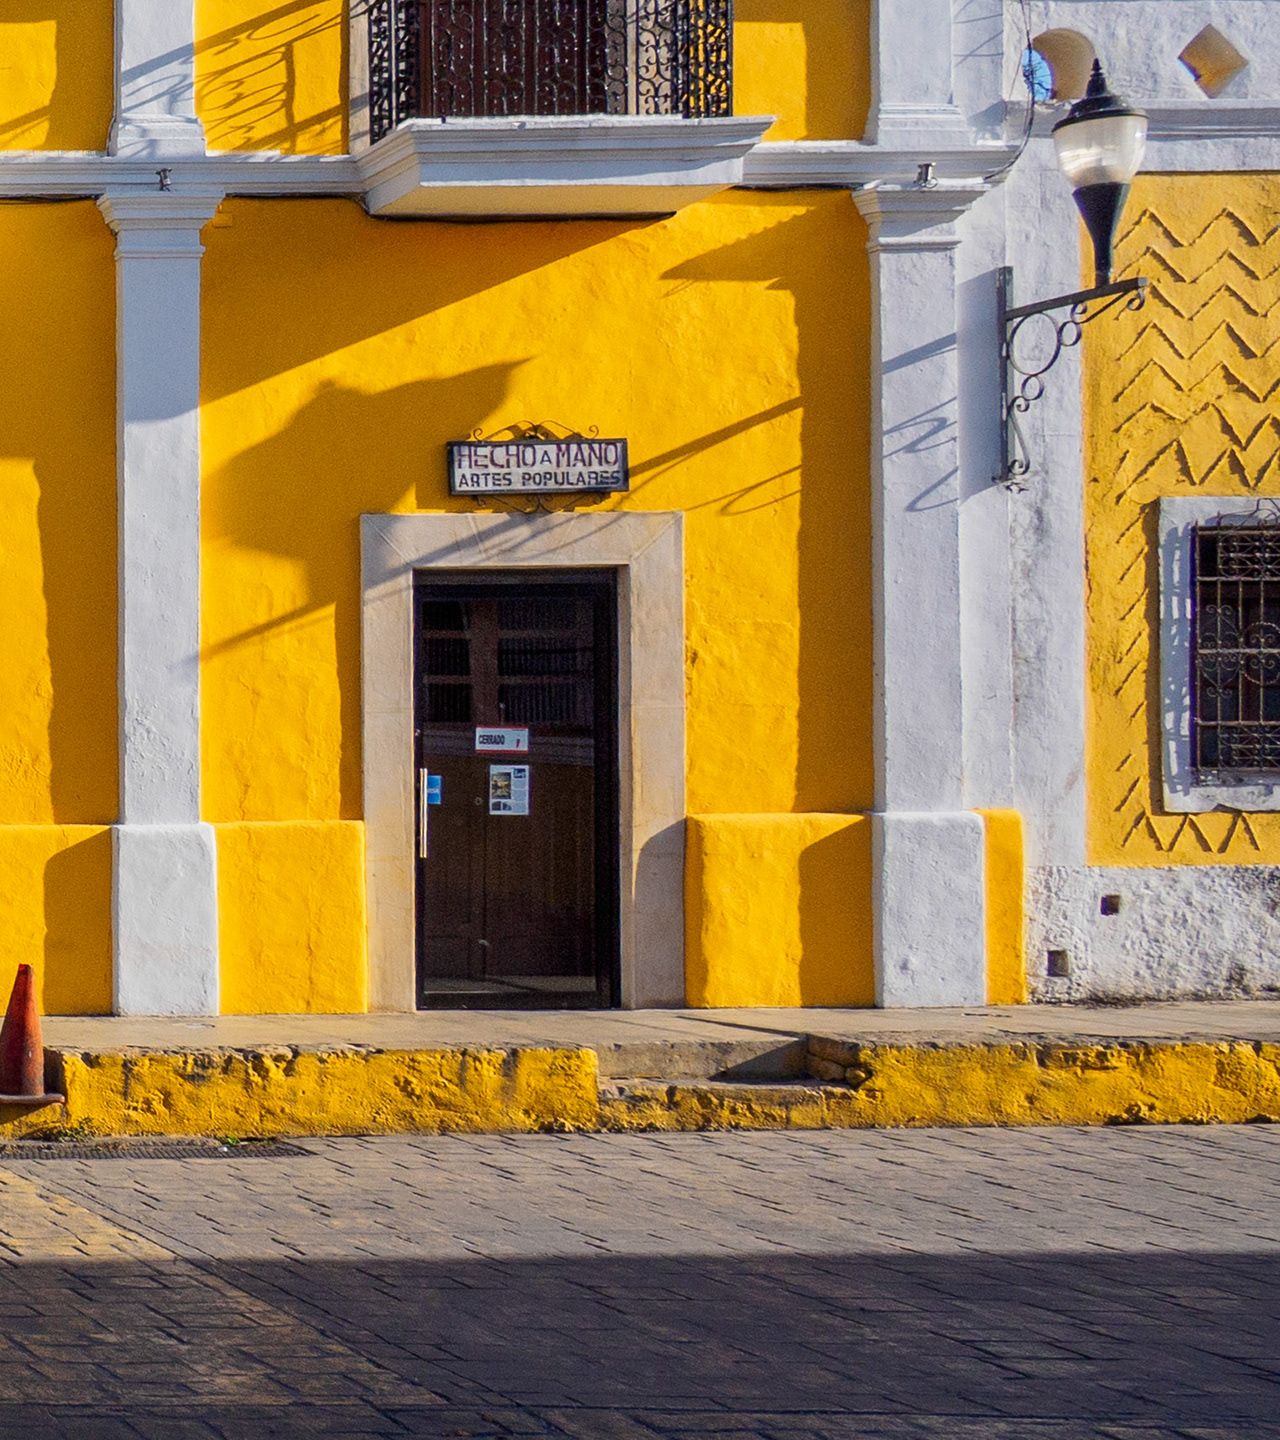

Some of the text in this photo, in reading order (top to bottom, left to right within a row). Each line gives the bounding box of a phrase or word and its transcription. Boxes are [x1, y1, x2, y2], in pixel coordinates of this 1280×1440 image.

[457, 443, 619, 469] HECHO A MANO
[458, 470, 622, 488] ARTES POPULARES
[479, 735, 505, 745] CERRADO
